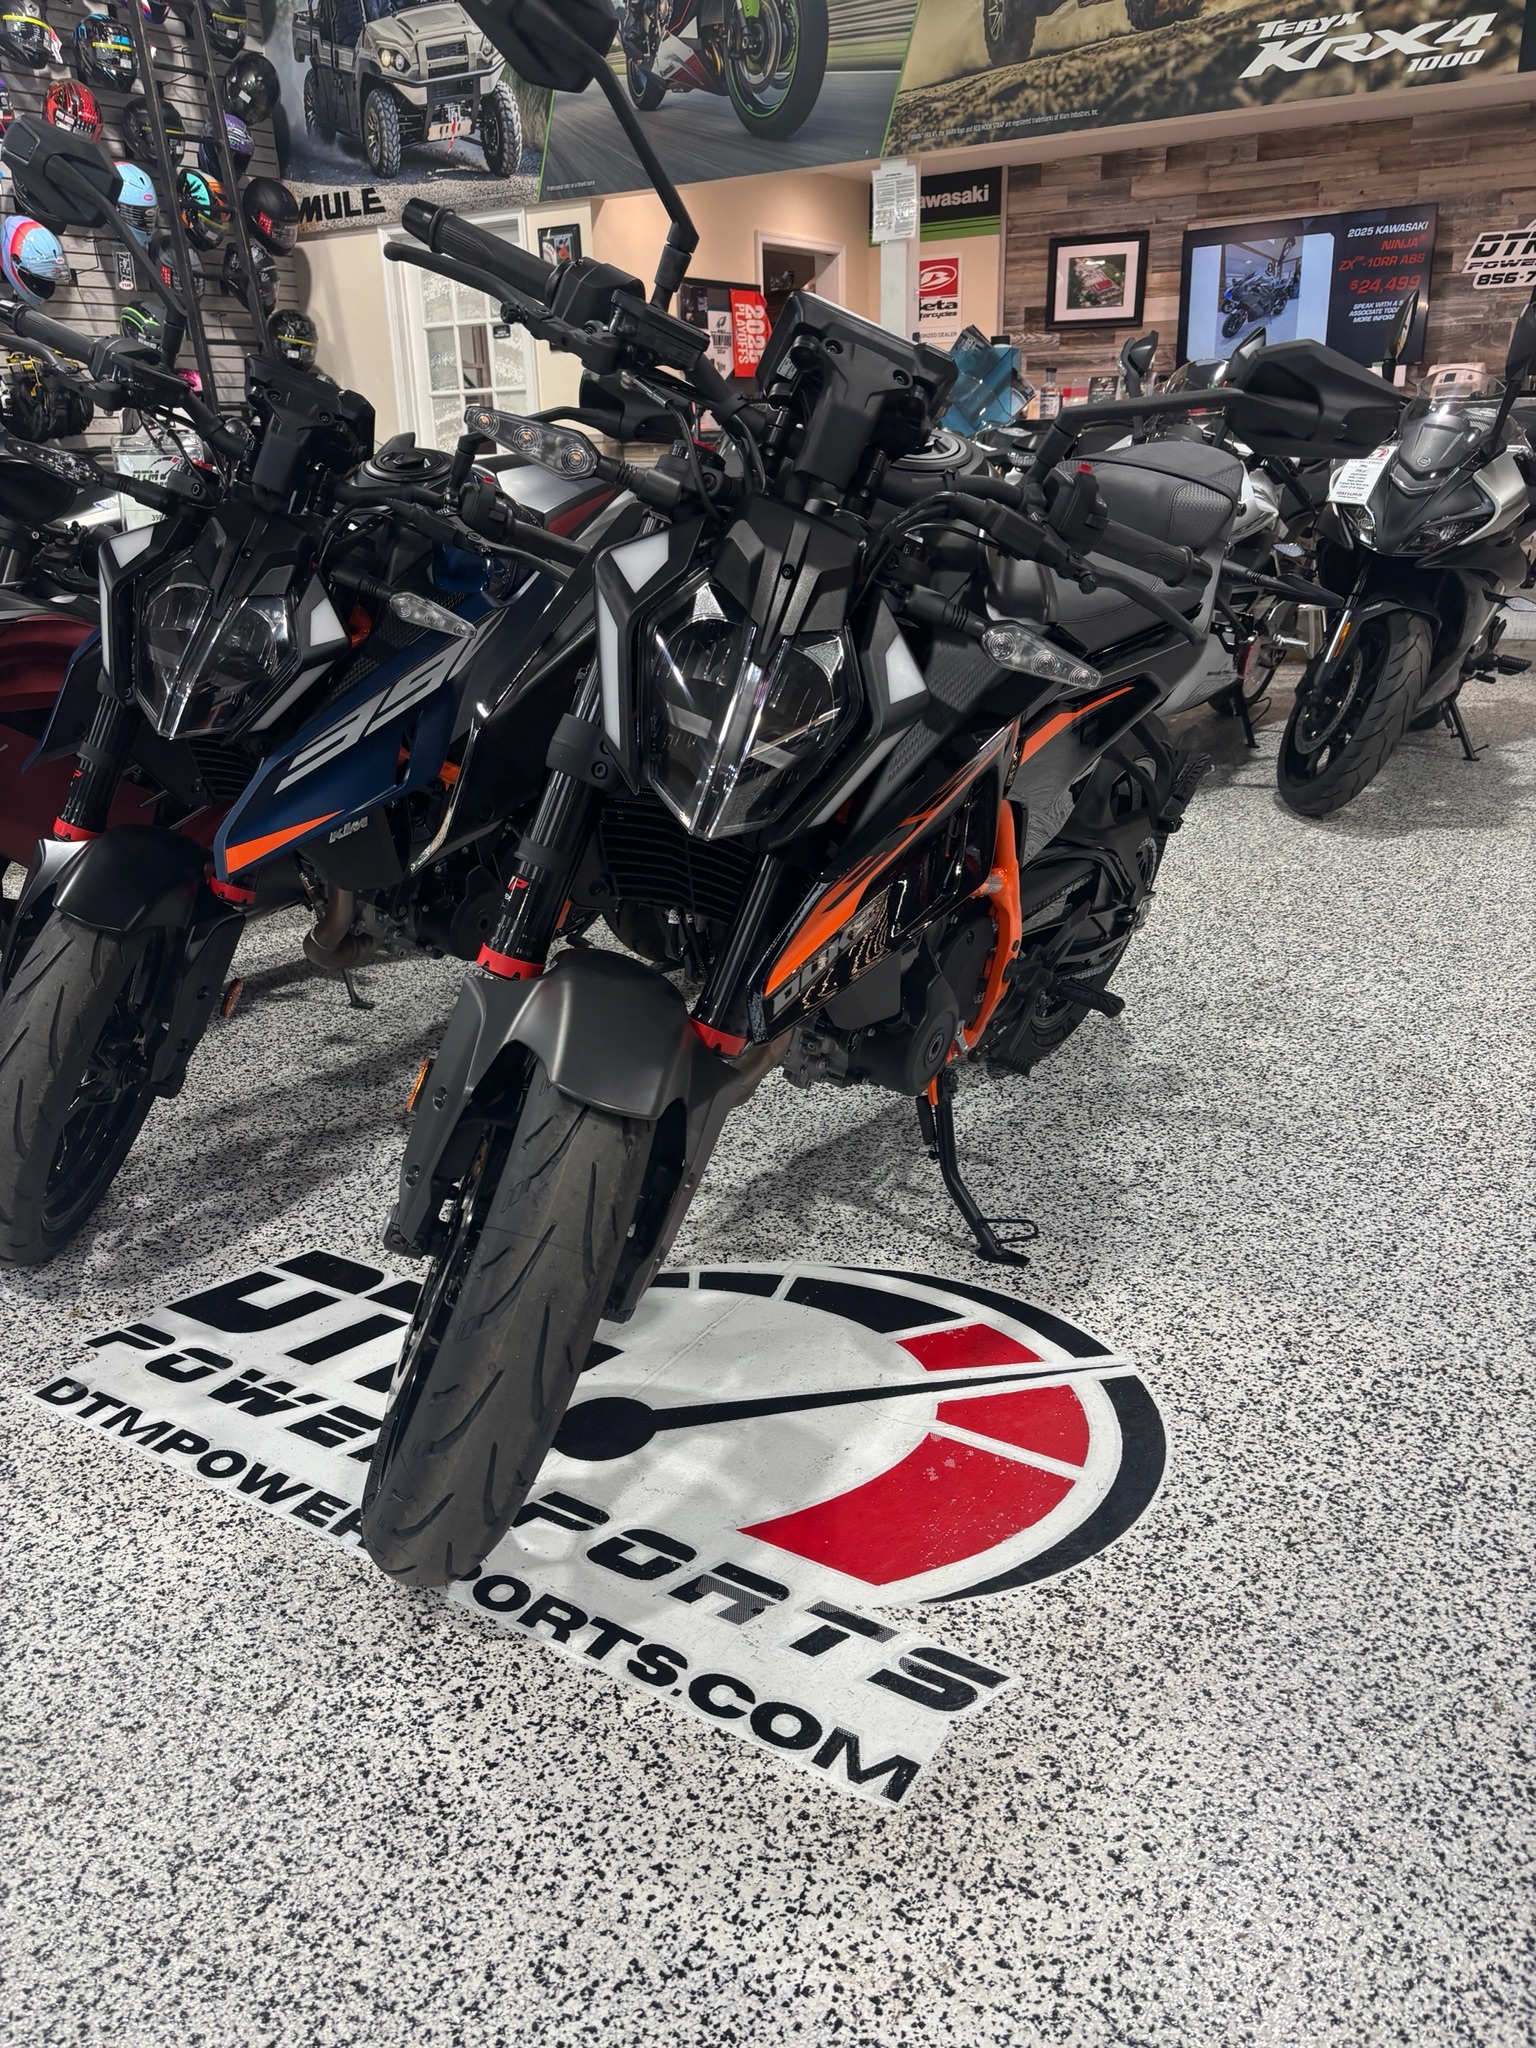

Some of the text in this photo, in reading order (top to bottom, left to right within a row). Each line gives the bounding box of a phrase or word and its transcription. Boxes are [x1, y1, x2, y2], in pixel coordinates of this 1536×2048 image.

[1256, 11, 1363, 39] TERYX
[1407, 49, 1486, 73] 1000
[1012, 118, 1031, 127] registered
[1032, 114, 1053, 124] trademarks
[299, 188, 386, 223] MULE
[920, 184, 989, 209] awasaki
[1347, 221, 1429, 237] 2025 KAWASAKI
[1400, 253, 1425, 264] ABS
[1467, 258, 1536, 270] POWE
[1349, 275, 1420, 294] $24,499
[919, 298, 958, 311] eta
[1348, 308, 1383, 317] ASSOCIATE
[920, 311, 957, 319] torcycles
[1372, 314, 1395, 322] INFOR
[734, 303, 750, 364] PLAYOFFS
[745, 303, 766, 364] 2025
[329, 816, 368, 844] KTM
[34, 1376, 920, 1802] DTMPOWEORTS.COM
